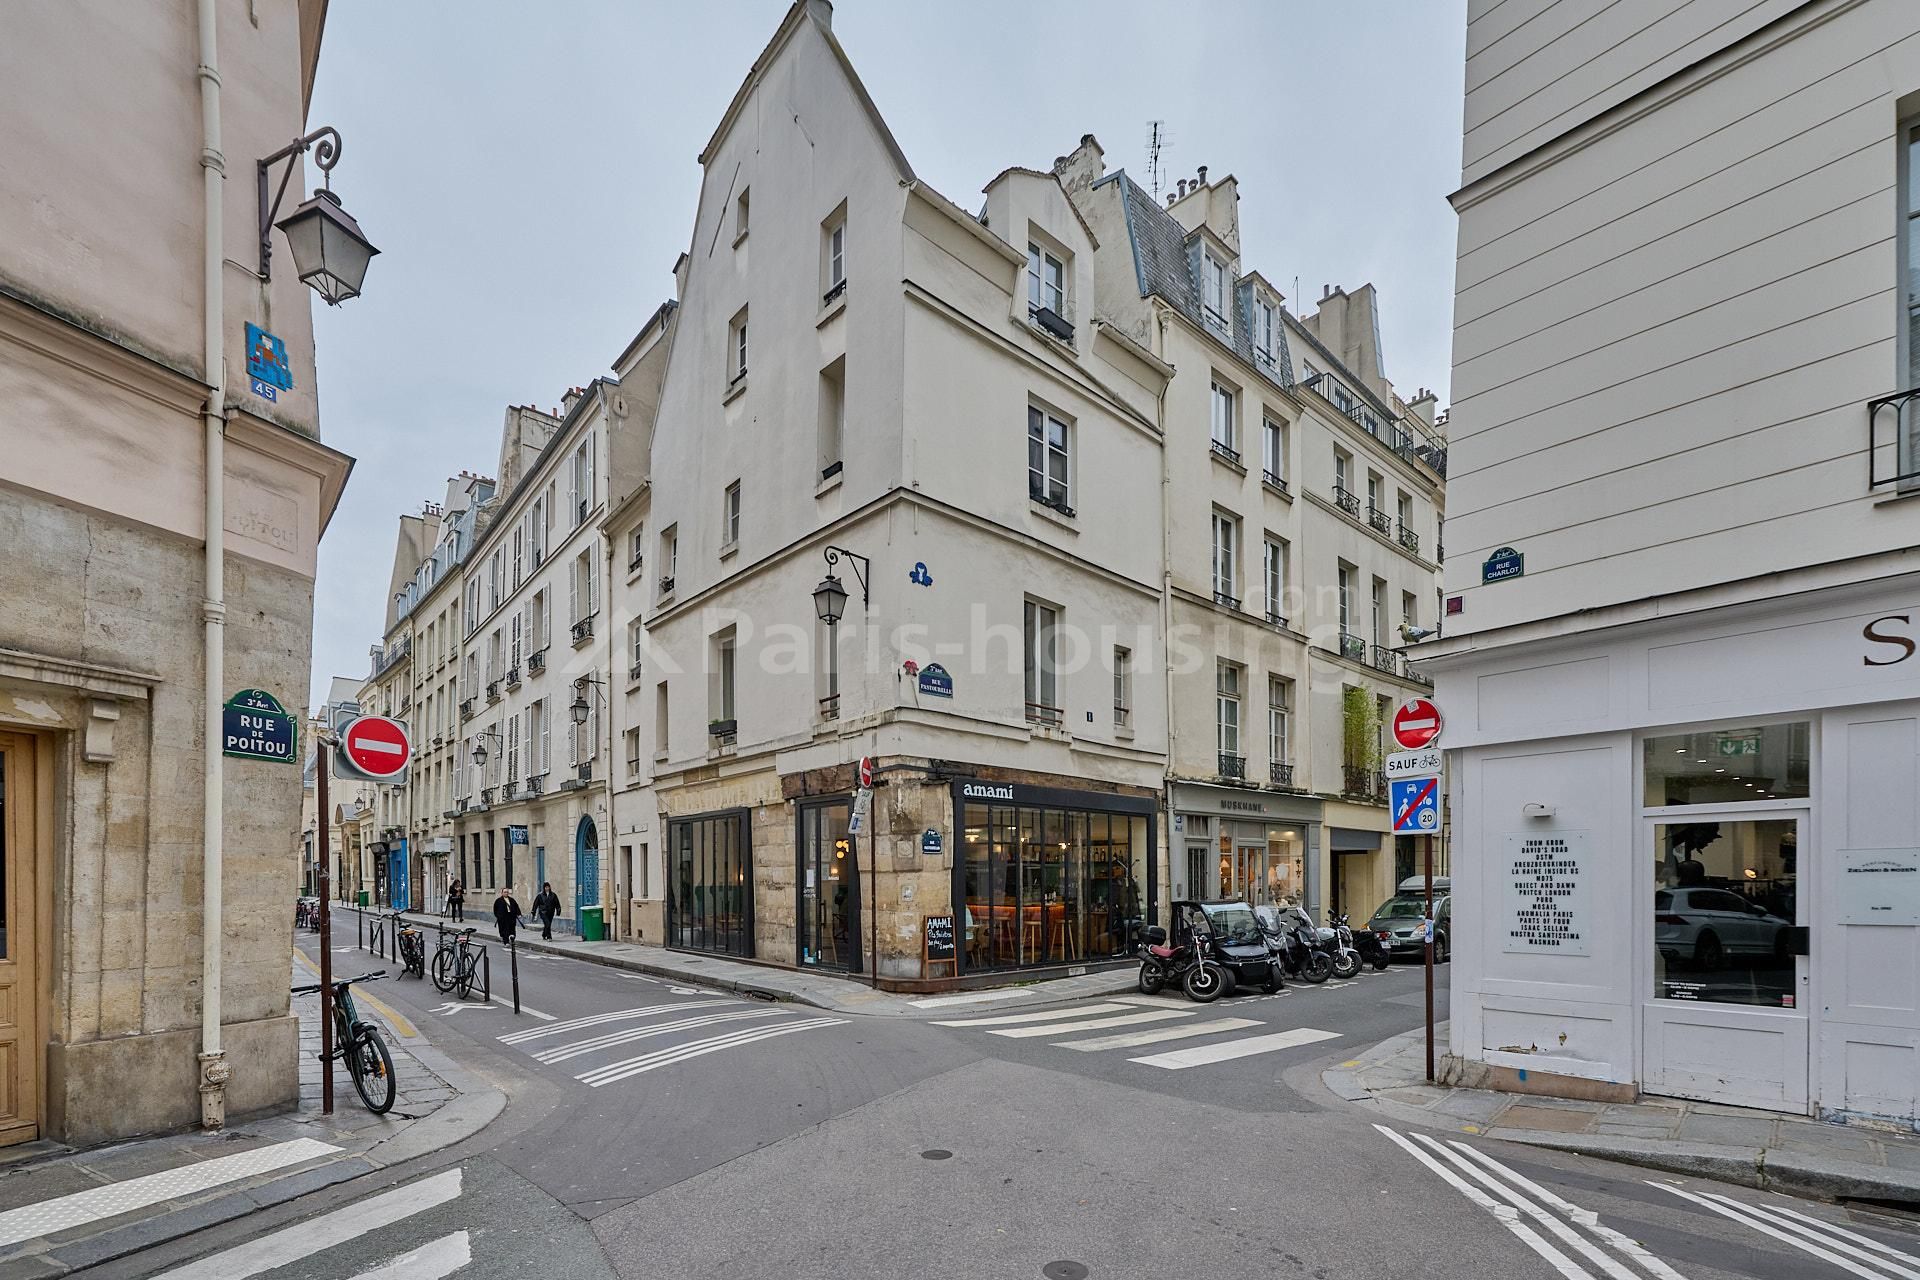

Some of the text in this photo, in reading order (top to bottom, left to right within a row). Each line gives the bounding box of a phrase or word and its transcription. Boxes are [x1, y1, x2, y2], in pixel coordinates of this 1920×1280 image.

[256, 383, 273, 398] 45
[1488, 566, 1519, 578] CHARLOT
[1496, 562, 1510, 570] RUE
[1863, 616, 1916, 666] S
[240, 714, 274, 732] RUE
[252, 730, 264, 738] DE
[228, 736, 286, 754] POITOU
[1389, 758, 1418, 771] SAUF
[964, 784, 1013, 799] amami
[1422, 814, 1432, 823] 20
[1538, 932, 1579, 940] SANTISSIMA
